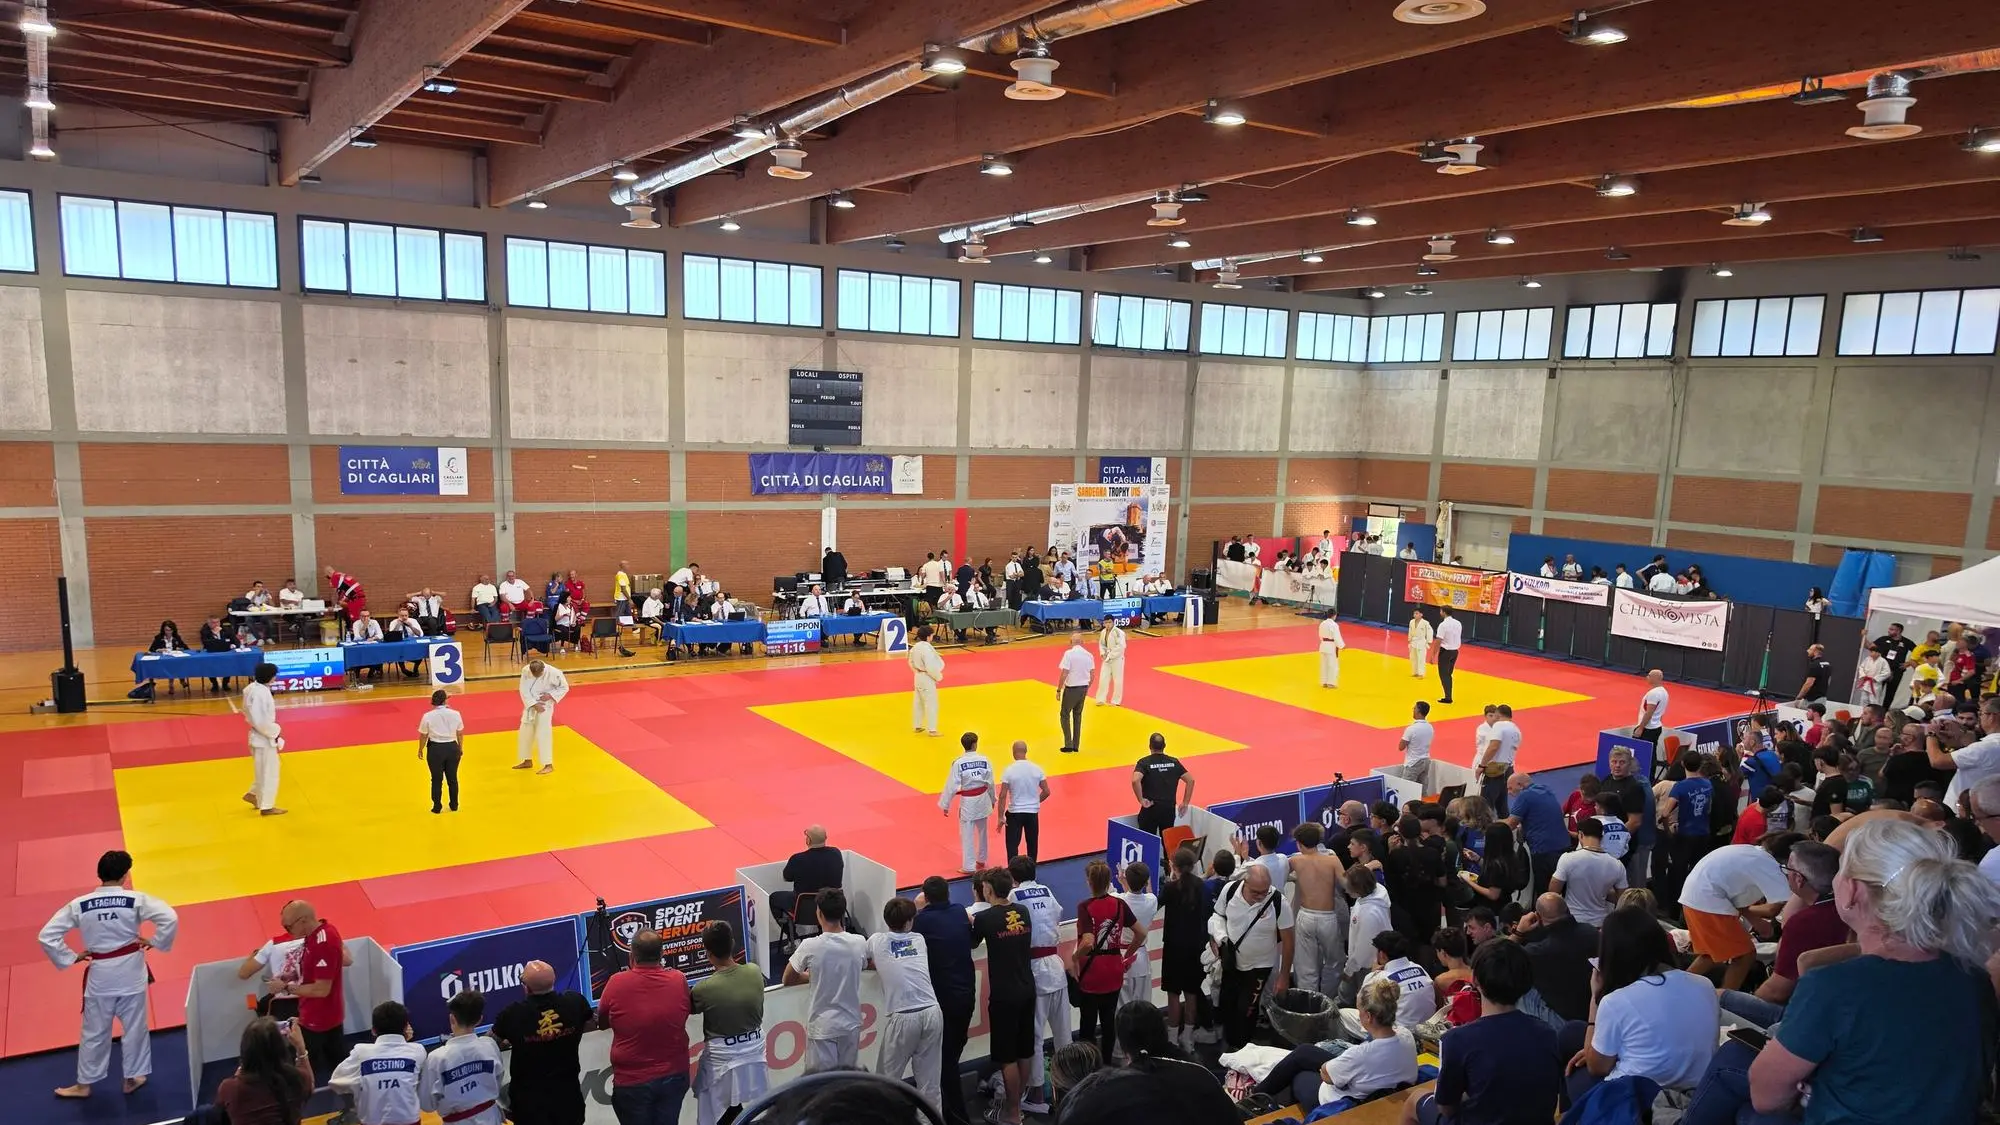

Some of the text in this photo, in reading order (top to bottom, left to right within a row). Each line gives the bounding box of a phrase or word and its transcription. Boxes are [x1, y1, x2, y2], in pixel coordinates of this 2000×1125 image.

[347, 457, 390, 470] CITTÀ
[1103, 465, 1126, 474] CITTÀ
[348, 473, 363, 484] DI
[368, 473, 435, 484] CAGLIARI
[761, 472, 801, 487] CITTÀ
[805, 475, 819, 487] DI
[822, 475, 885, 487] CAGLIARI
[1103, 476, 1111, 484] DI
[1113, 476, 1149, 484] CAGLIARI
[1077, 486, 1107, 498] SARDEGNA
[1108, 486, 1130, 497] TROPHY
[1191, 598, 1199, 627] 1
[795, 621, 820, 631] IPPON
[1114, 618, 1131, 627] 0:59
[806, 631, 812, 639] 0
[887, 619, 907, 651] 2
[783, 642, 806, 654] 1:16
[435, 644, 462, 684] 3
[323, 665, 333, 676] 0
[288, 677, 323, 691] 2:05
[87, 898, 127, 909] A.FAGIANO
[1032, 902, 1046, 910] ITA
[655, 900, 705, 920] SPORT
[97, 912, 119, 921] ITA
[654, 911, 703, 931] EVENT
[662, 940, 687, 950] EVENTO
[684, 943, 703, 951] TUTTO
[468, 962, 526, 994] FIJLKA
[1407, 980, 1425, 992] ITA
[372, 1060, 406, 1071] CESTINO
[378, 1078, 401, 1090] ITA
[460, 1080, 478, 1094] ITA
